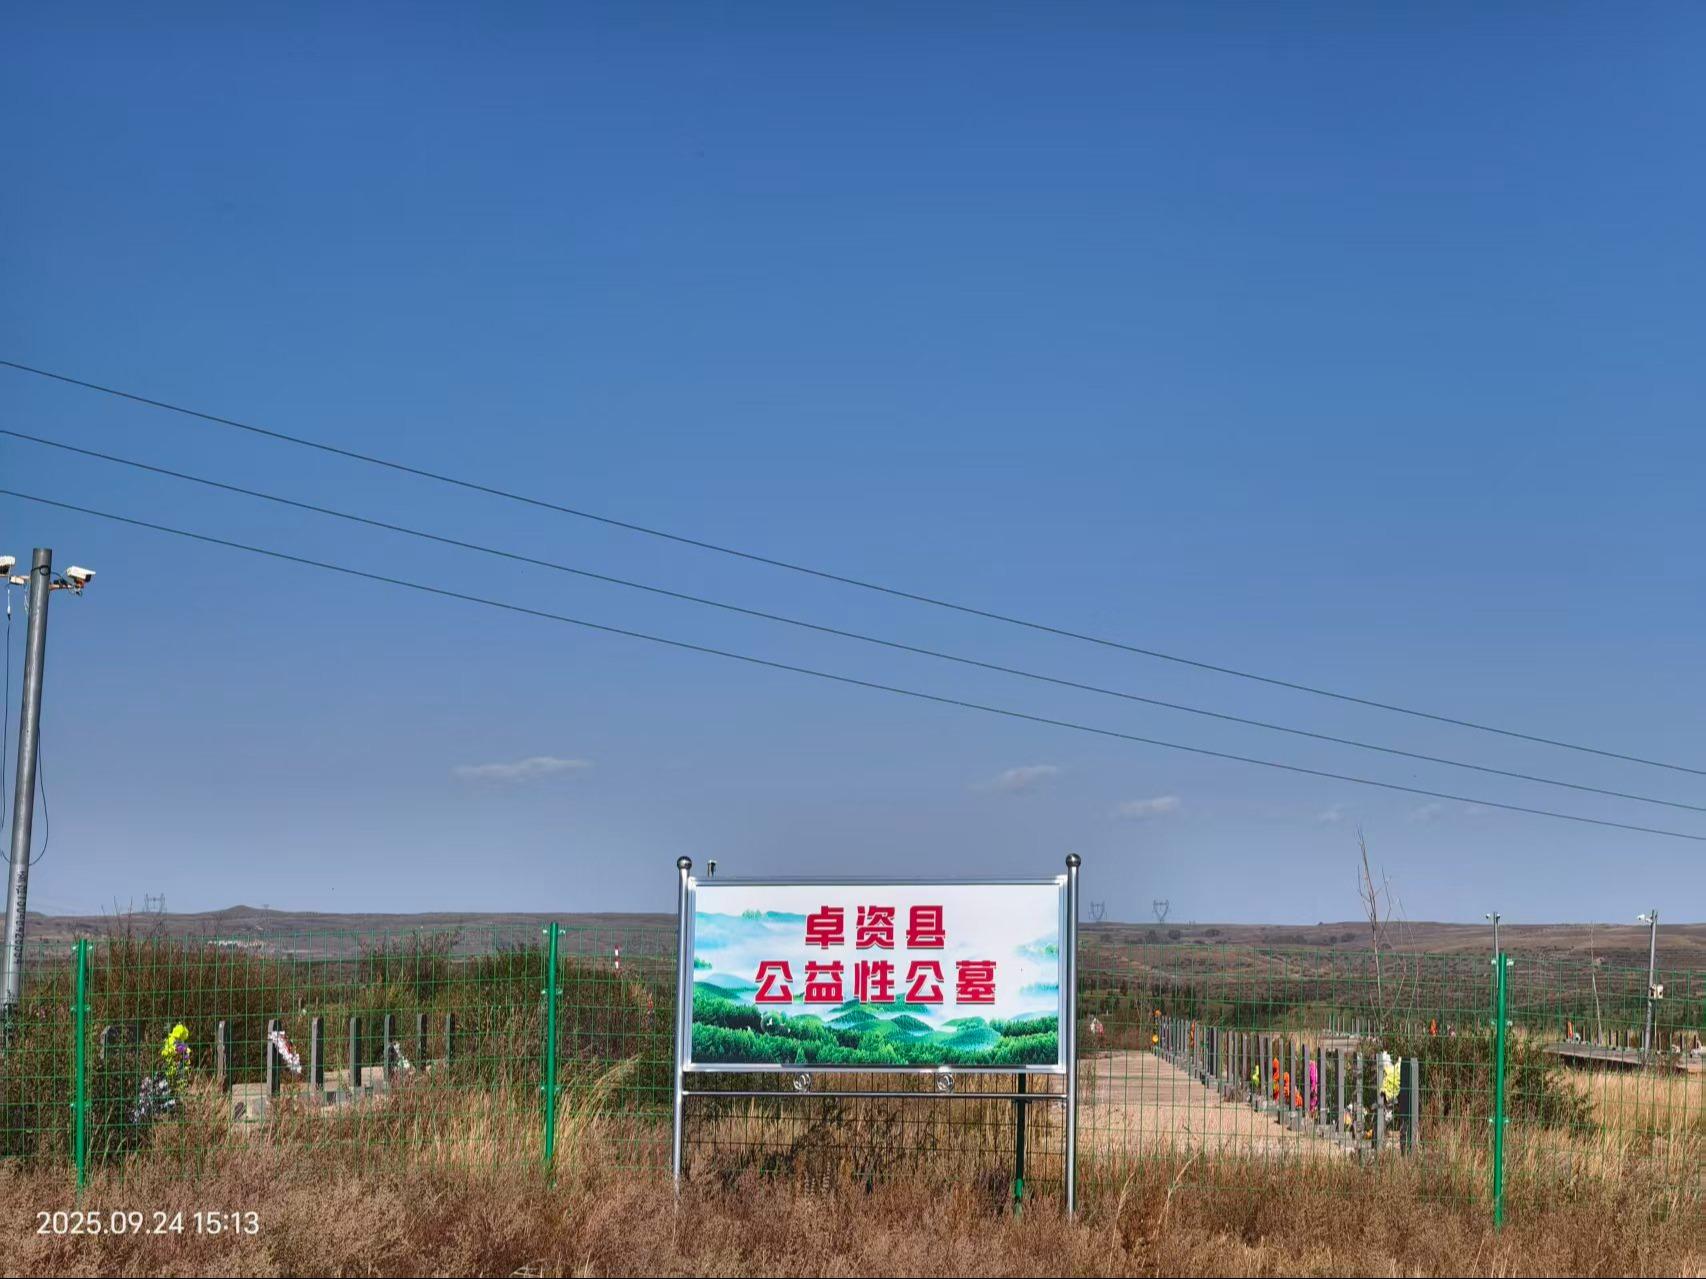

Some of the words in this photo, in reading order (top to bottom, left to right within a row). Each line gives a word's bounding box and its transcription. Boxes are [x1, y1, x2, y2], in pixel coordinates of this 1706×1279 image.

[805, 905, 945, 950] 卓资县
[755, 960, 996, 1005] 公益性公墓
